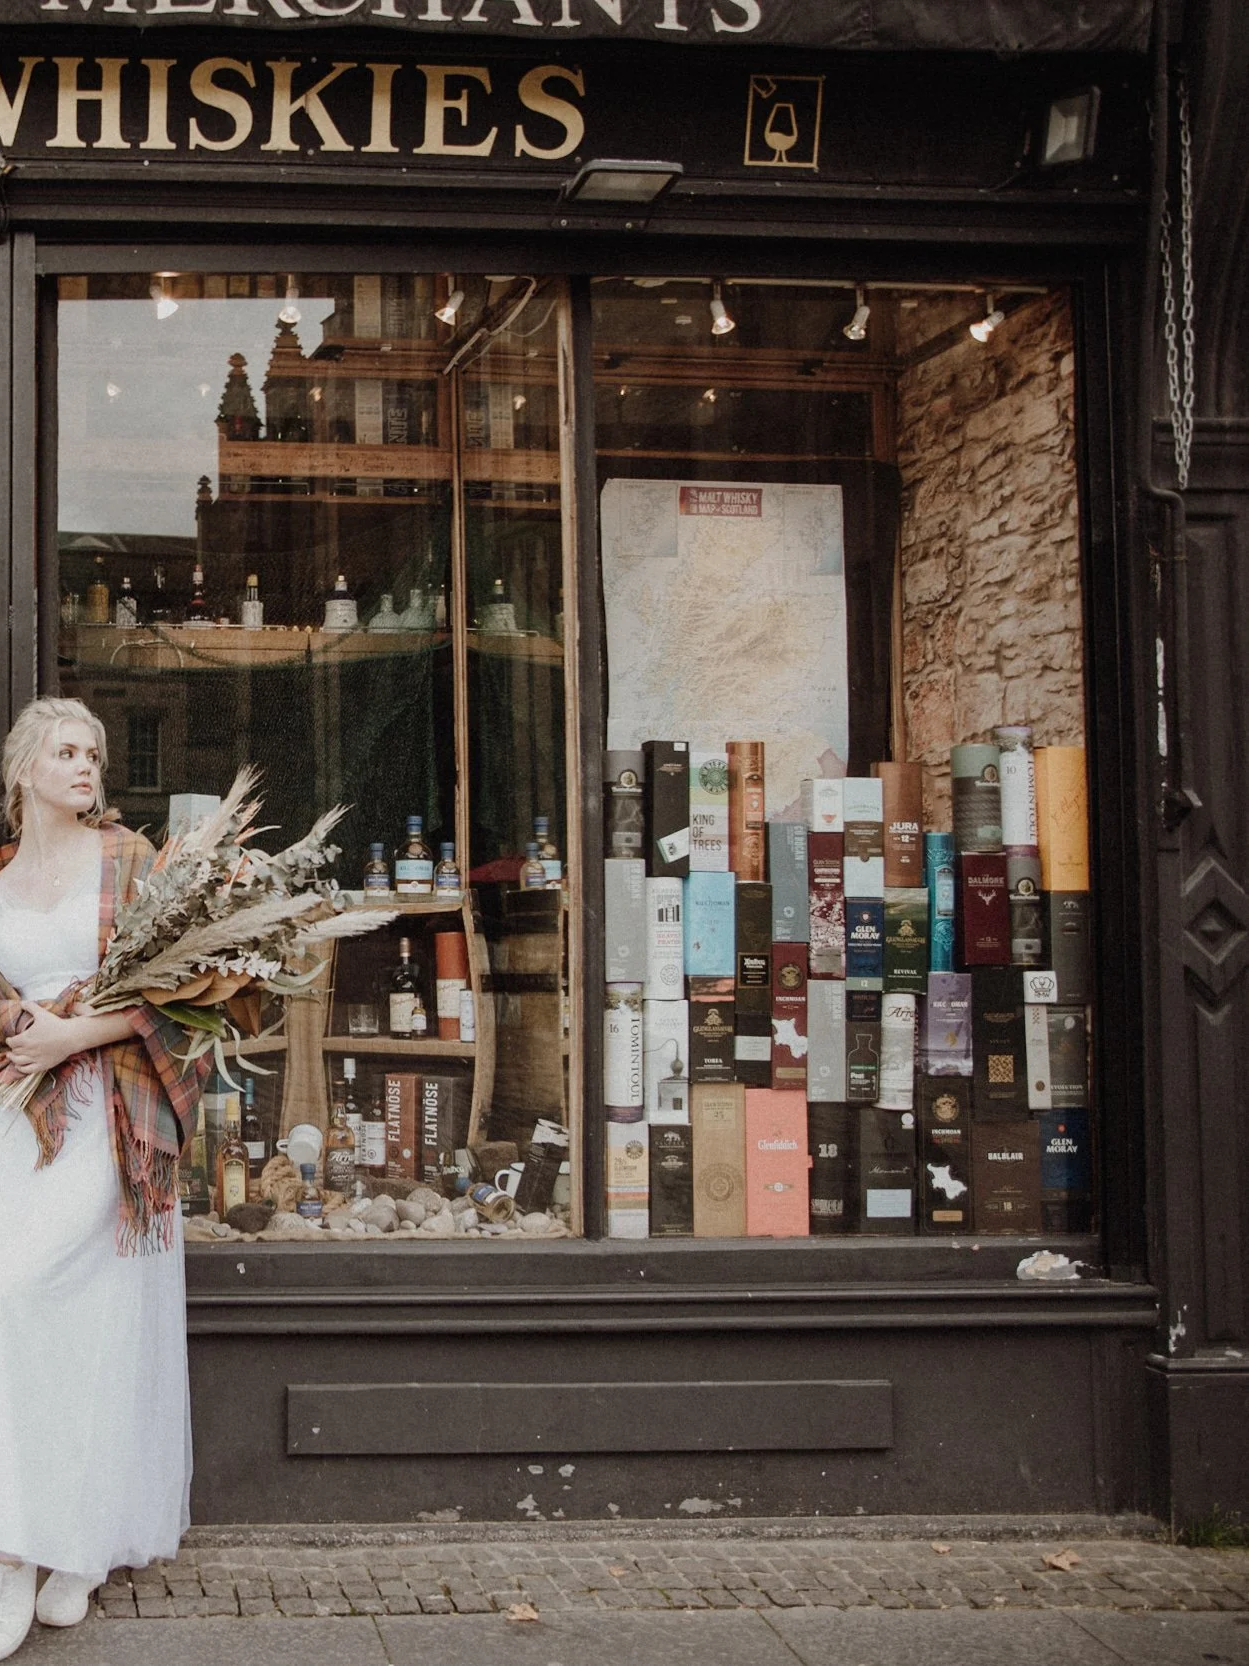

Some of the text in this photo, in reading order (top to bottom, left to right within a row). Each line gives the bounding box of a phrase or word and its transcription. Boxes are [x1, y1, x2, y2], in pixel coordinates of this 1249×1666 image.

[698, 491, 722, 503] MALT
[723, 492, 758, 504] WHISKY
[1006, 766, 1017, 775] 10
[1027, 759, 1037, 841] TOMINTOUL
[692, 815, 715, 825] KING
[692, 826, 704, 837] OF
[889, 822, 919, 832] JURA
[901, 834, 910, 843] 12
[692, 840, 722, 851] TREES
[967, 876, 1005, 884] DALMORE
[855, 925, 876, 933] GLEN
[850, 932, 880, 940] MORAY
[609, 1023, 620, 1034] 16
[630, 1018, 640, 1101] TOMINTOUL
[387, 1079, 401, 1143] FLATNÖSE
[424, 1081, 439, 1146] FLATNÖSE
[758, 1139, 799, 1150] Glenfiddich
[1050, 1138, 1073, 1146] GLEN
[818, 1144, 838, 1158] 18
[1046, 1145, 1078, 1153] MORAY
[987, 1152, 1024, 1161] BALBLAIR
